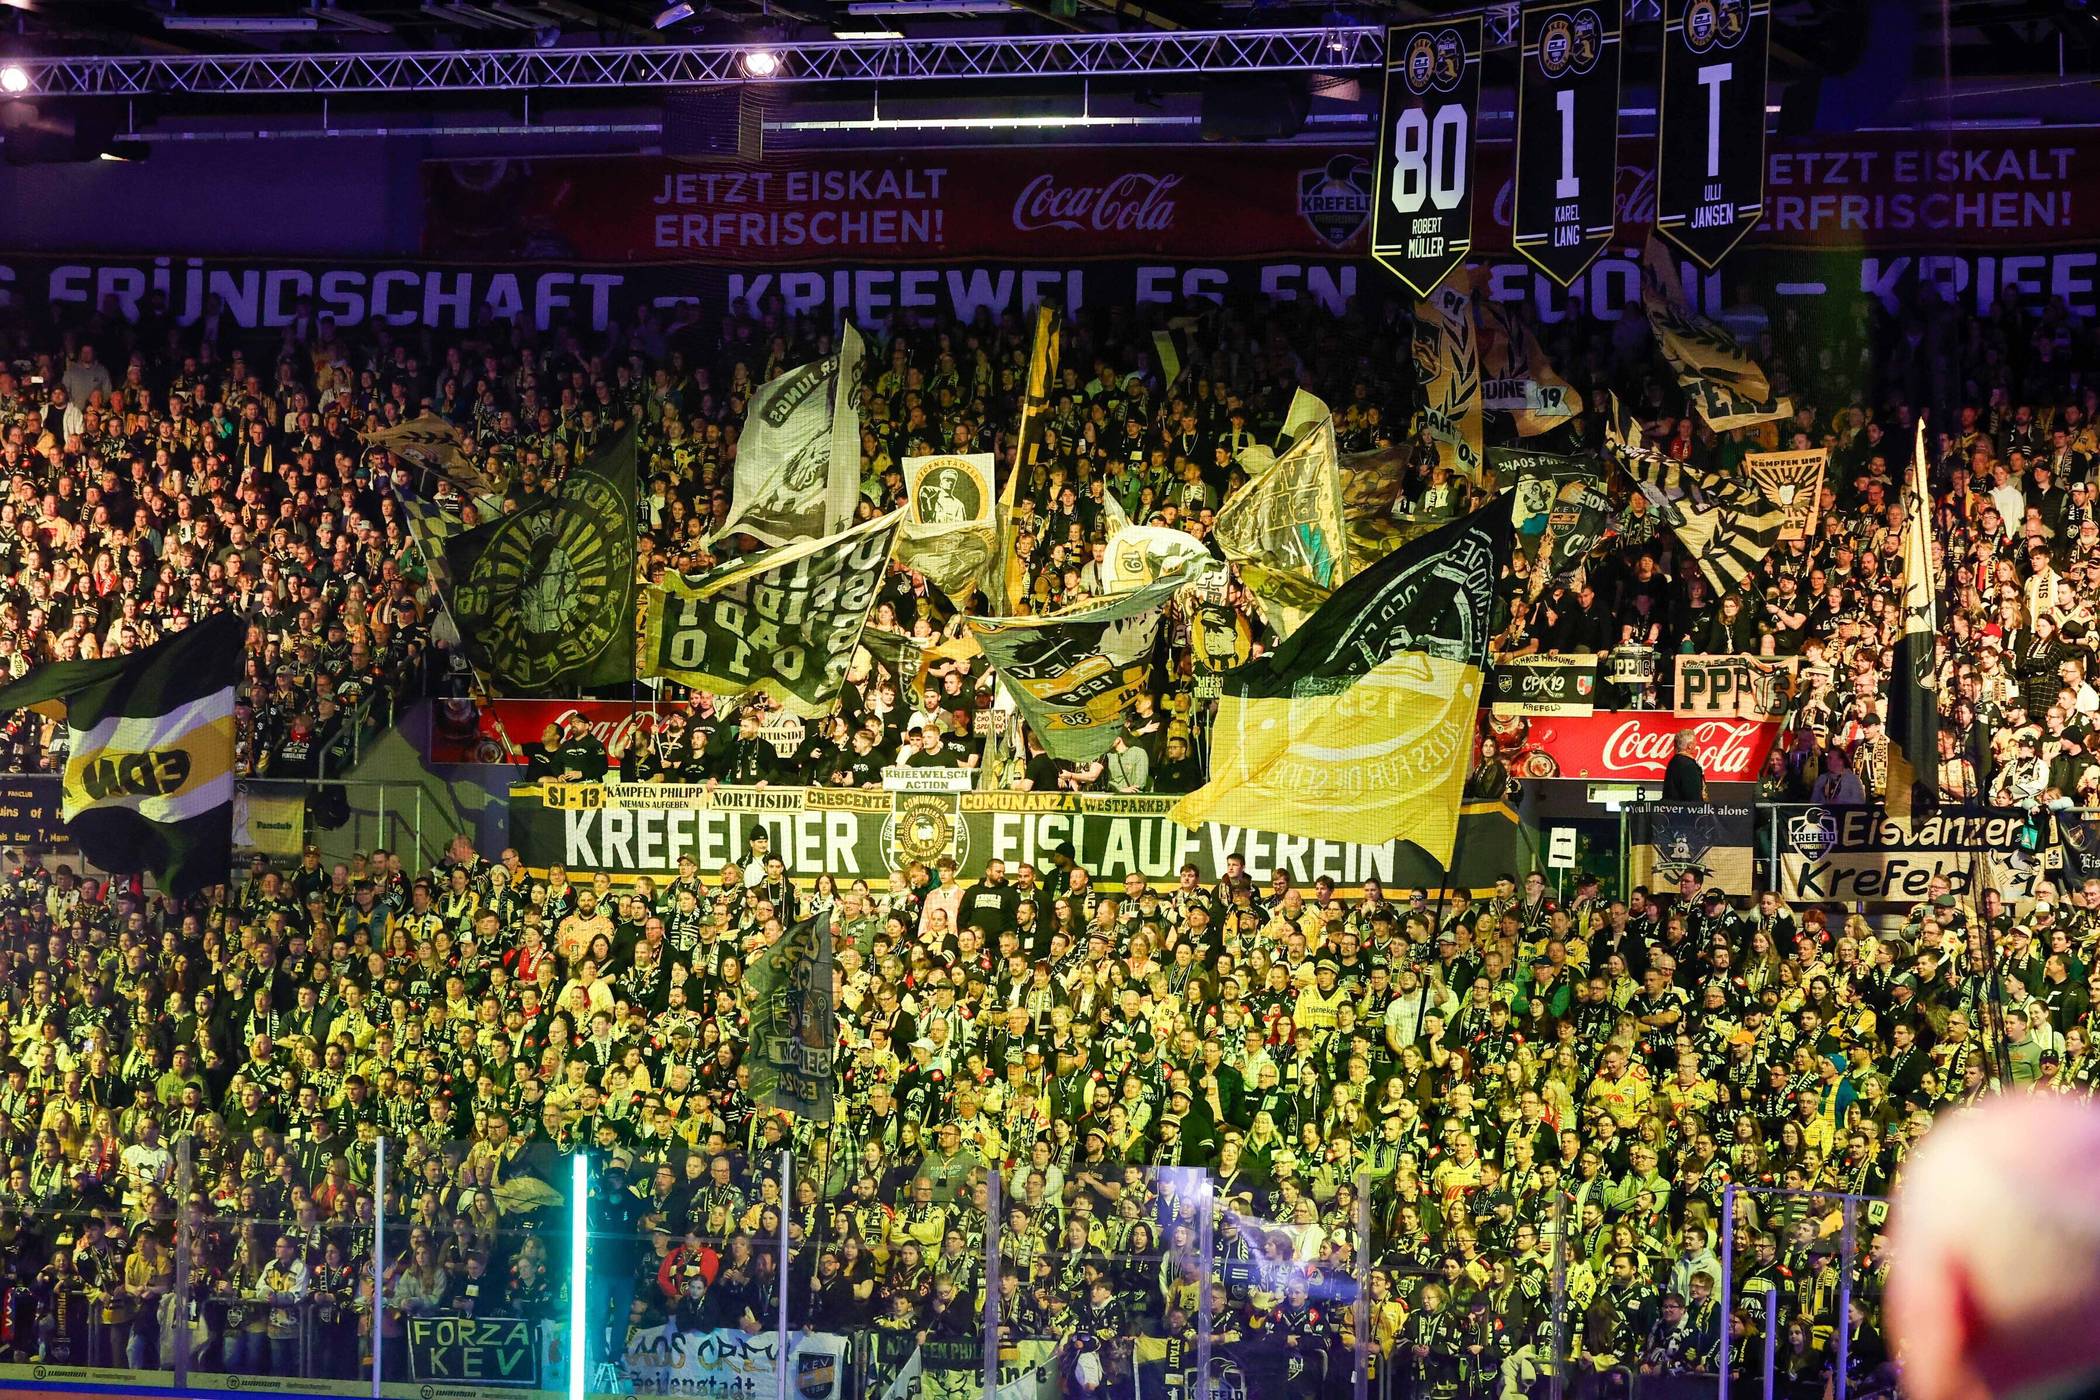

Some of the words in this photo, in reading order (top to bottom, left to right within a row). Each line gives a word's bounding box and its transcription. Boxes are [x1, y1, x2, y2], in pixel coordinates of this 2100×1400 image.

[1697, 62, 1733, 178] T
[1556, 89, 1580, 199] 1
[1392, 103, 1468, 213] 80
[1769, 151, 1879, 184] ETZT
[1893, 148, 2076, 183] EISKALT
[653, 172, 773, 204] JETZT
[786, 168, 947, 201] EISKALT
[1704, 182, 1722, 202] ULLI
[1012, 173, 1184, 232] Coca-Cola
[1555, 204, 1580, 223] KAREL
[1690, 203, 1734, 230] JANSEN
[654, 209, 944, 248] ERFRISCHEN!
[1412, 216, 1442, 235] ROBERT
[1554, 223, 1580, 248] LANG
[1408, 236, 1444, 260] MÜLLER
[1541, 387, 1561, 408] 19
[1801, 456, 1822, 465] UND
[760, 731, 804, 741] RTHSIDE
[1602, 720, 1760, 773] Cocaola
[885, 769, 969, 779] KRIEEWELSCH
[607, 784, 657, 799] KÄMPFEN
[660, 787, 703, 799] PHILIPP
[905, 781, 949, 789] ACTION
[1636, 786, 1646, 800] B
[548, 788, 567, 807] SJ
[580, 788, 600, 808] 13
[620, 800, 650, 809] NIEMALS
[652, 801, 689, 810] AUFGEBEN
[713, 791, 802, 809] NORTHSIDE
[807, 790, 891, 809] CRESCENTE
[961, 793, 1076, 811] COMUNANZA
[31, 809, 42, 819] of
[1653, 804, 1684, 815] never
[1687, 803, 1715, 816] walk
[1718, 805, 1749, 817] alone
[256, 821, 292, 831] Fanclub
[1790, 831, 1836, 842] KREFELD
[413, 1319, 530, 1348] FORZA
[430, 1346, 526, 1378] KEV
